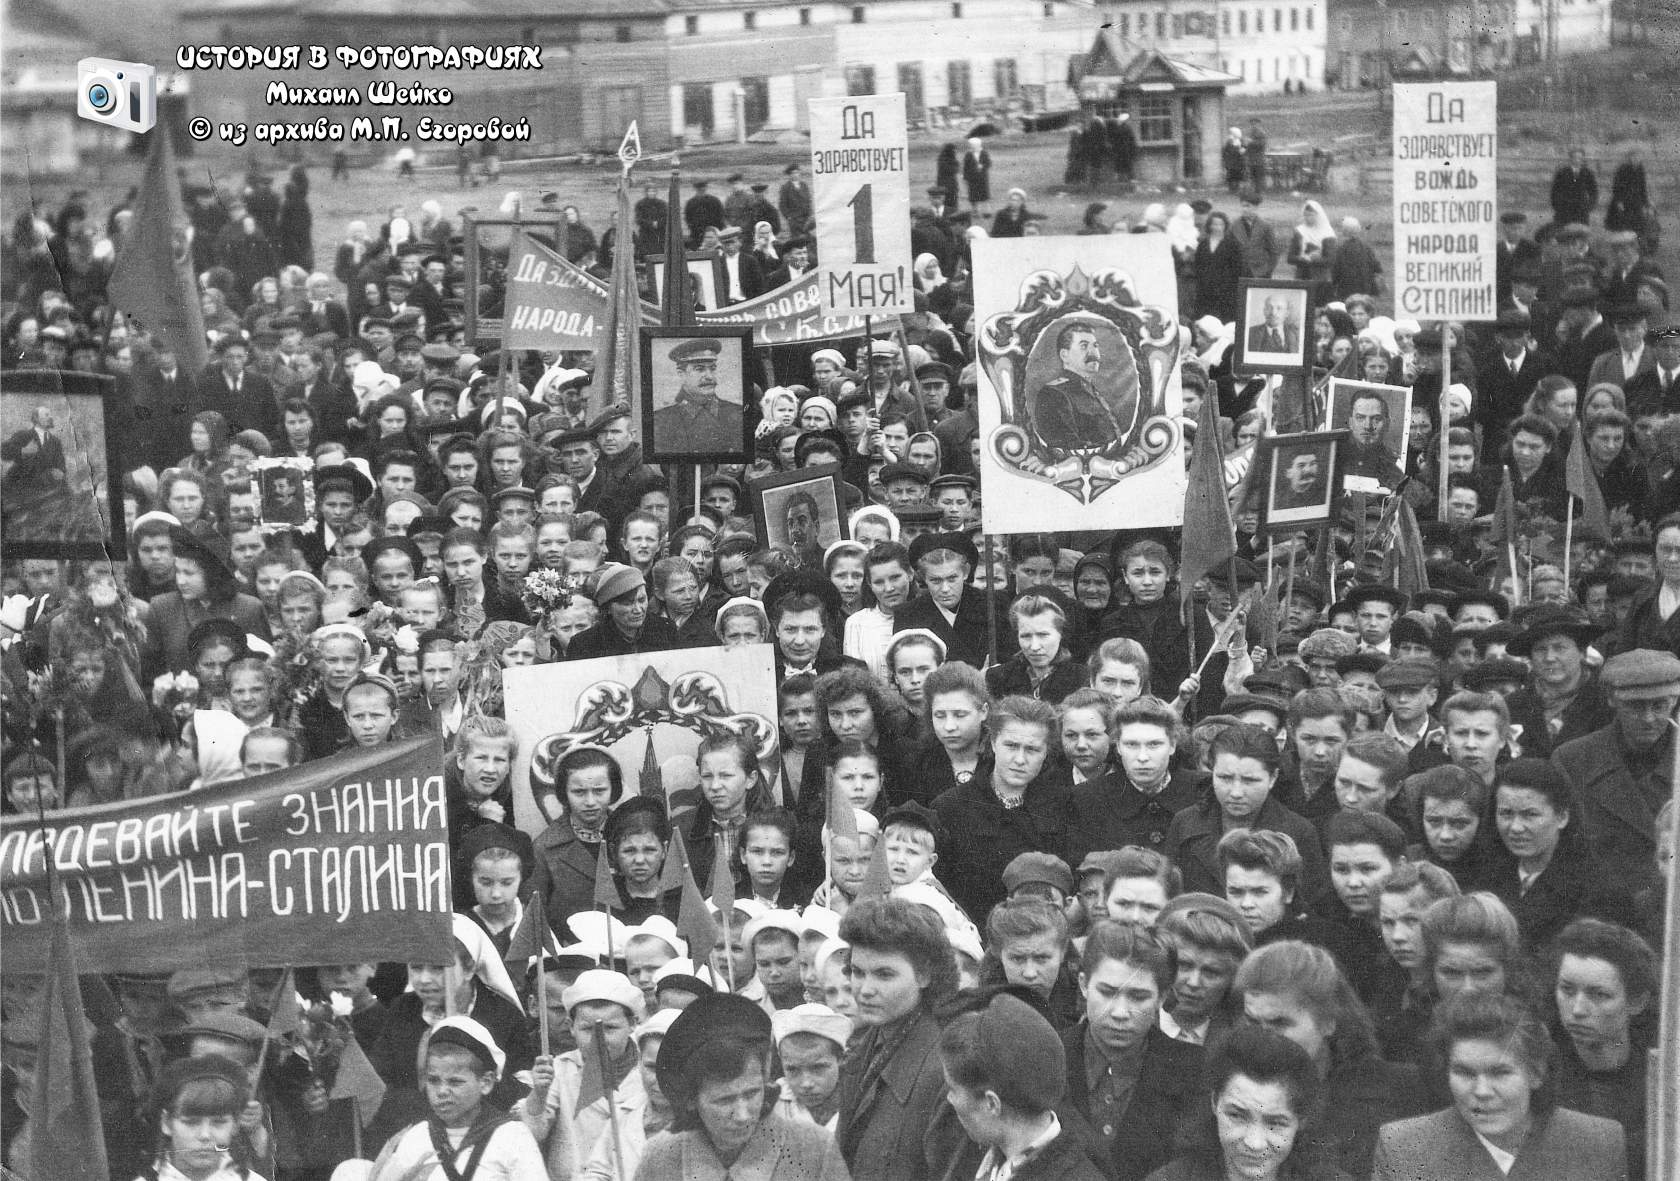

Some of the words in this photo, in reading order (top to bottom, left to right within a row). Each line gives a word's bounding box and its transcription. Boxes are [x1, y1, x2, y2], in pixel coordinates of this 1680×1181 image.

[1399, 134, 1495, 160] ЗДРАВСТВУЕТ
[814, 148, 904, 174] ЗДРАВСТВУЕТ
[1414, 168, 1479, 190] ВОЖДЬ
[847, 184, 878, 265] 1
[1401, 201, 1493, 224] СОВЕТСКОГО
[1407, 234, 1479, 254] НАРОДА
[1406, 256, 1482, 283] ВЕЛИКИЙ
[829, 265, 905, 309] МАЯ!
[0, 800, 259, 876] ЛАДЕВАЙТЕ
[281, 775, 447, 835] ЗНАНИЯ
